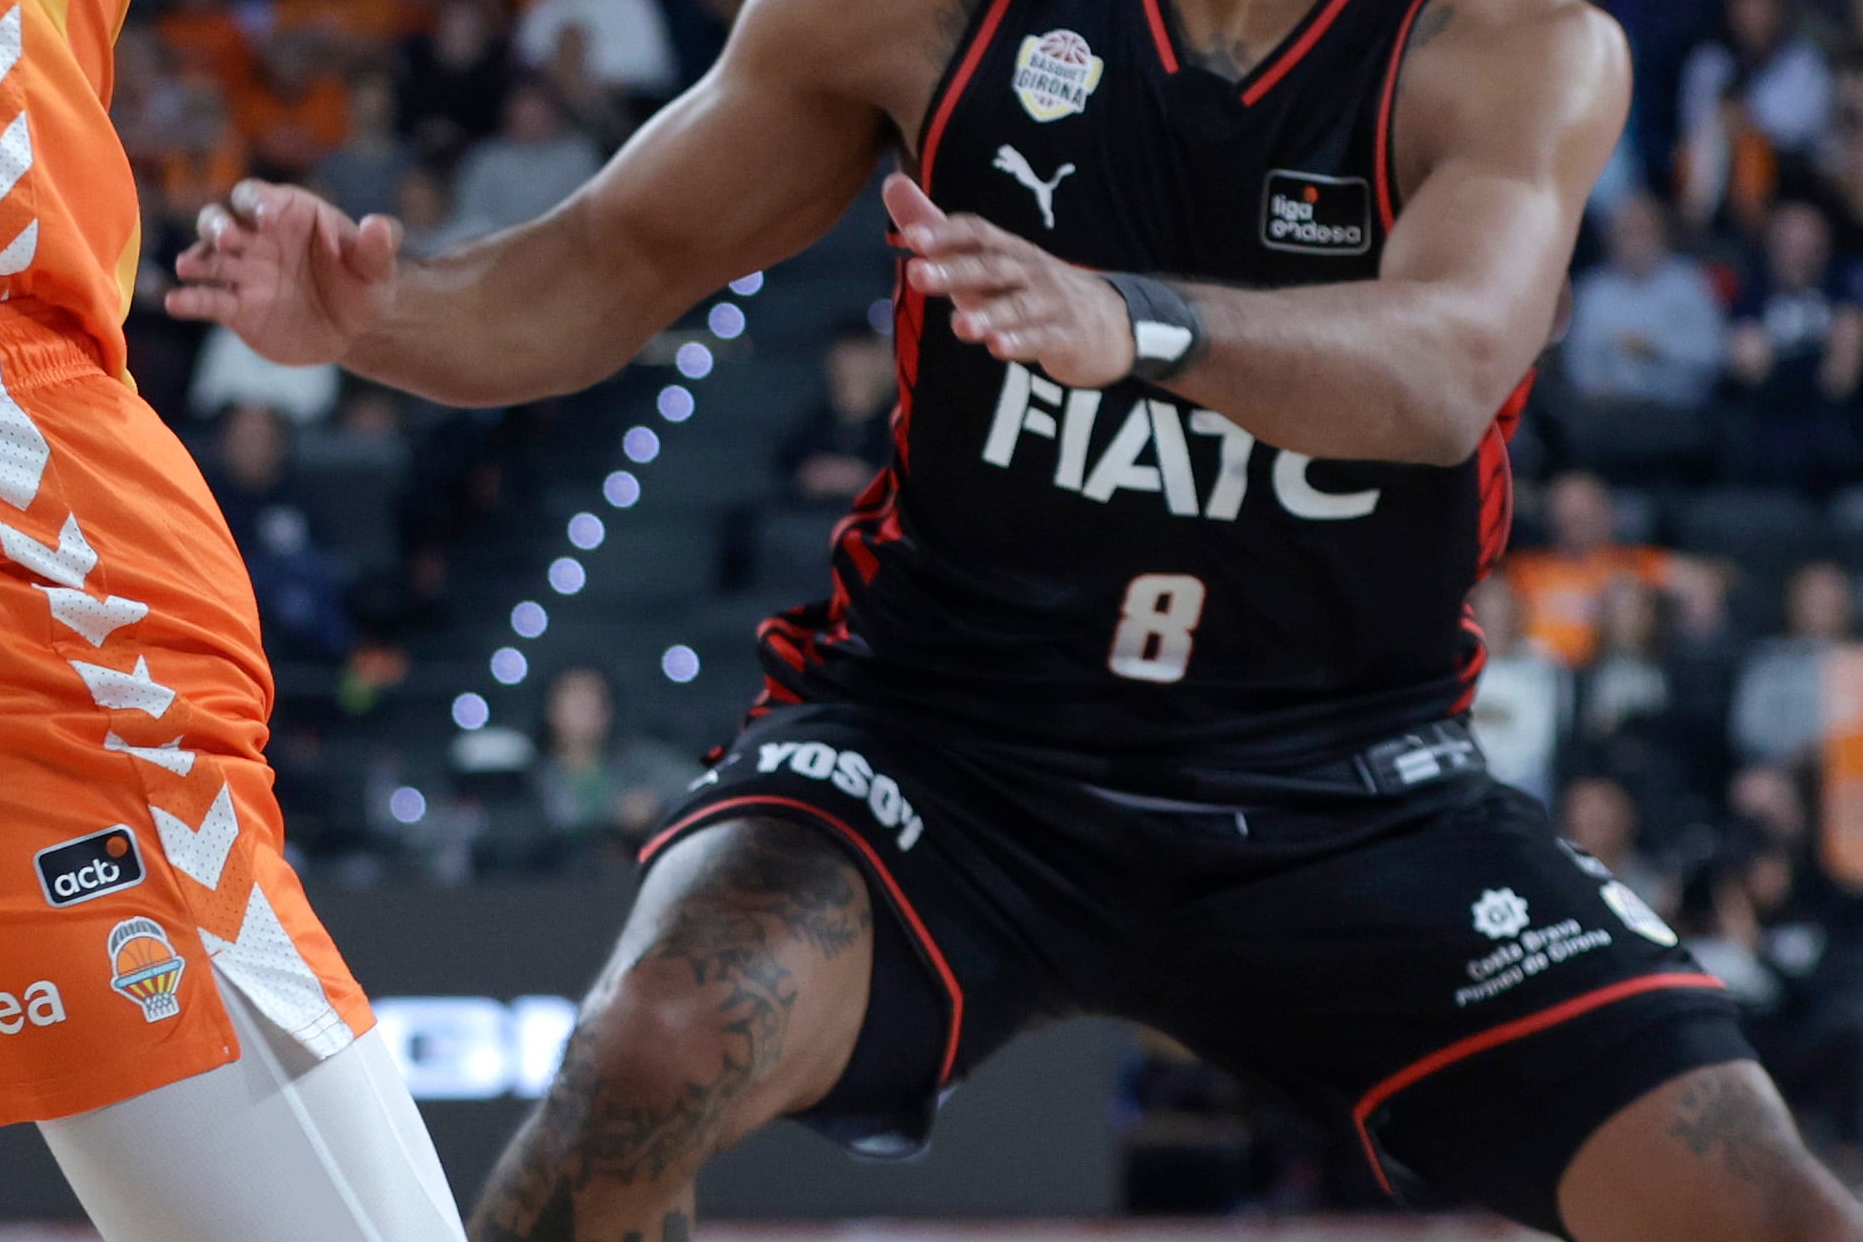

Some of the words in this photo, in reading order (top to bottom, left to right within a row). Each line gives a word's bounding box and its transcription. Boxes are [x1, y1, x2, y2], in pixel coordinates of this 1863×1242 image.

[1017, 69, 1083, 107] GIRONA
[1271, 193, 1313, 222] liga
[1270, 218, 1361, 244] endesa
[1108, 573, 1207, 684] 8
[54, 858, 120, 897] acb
